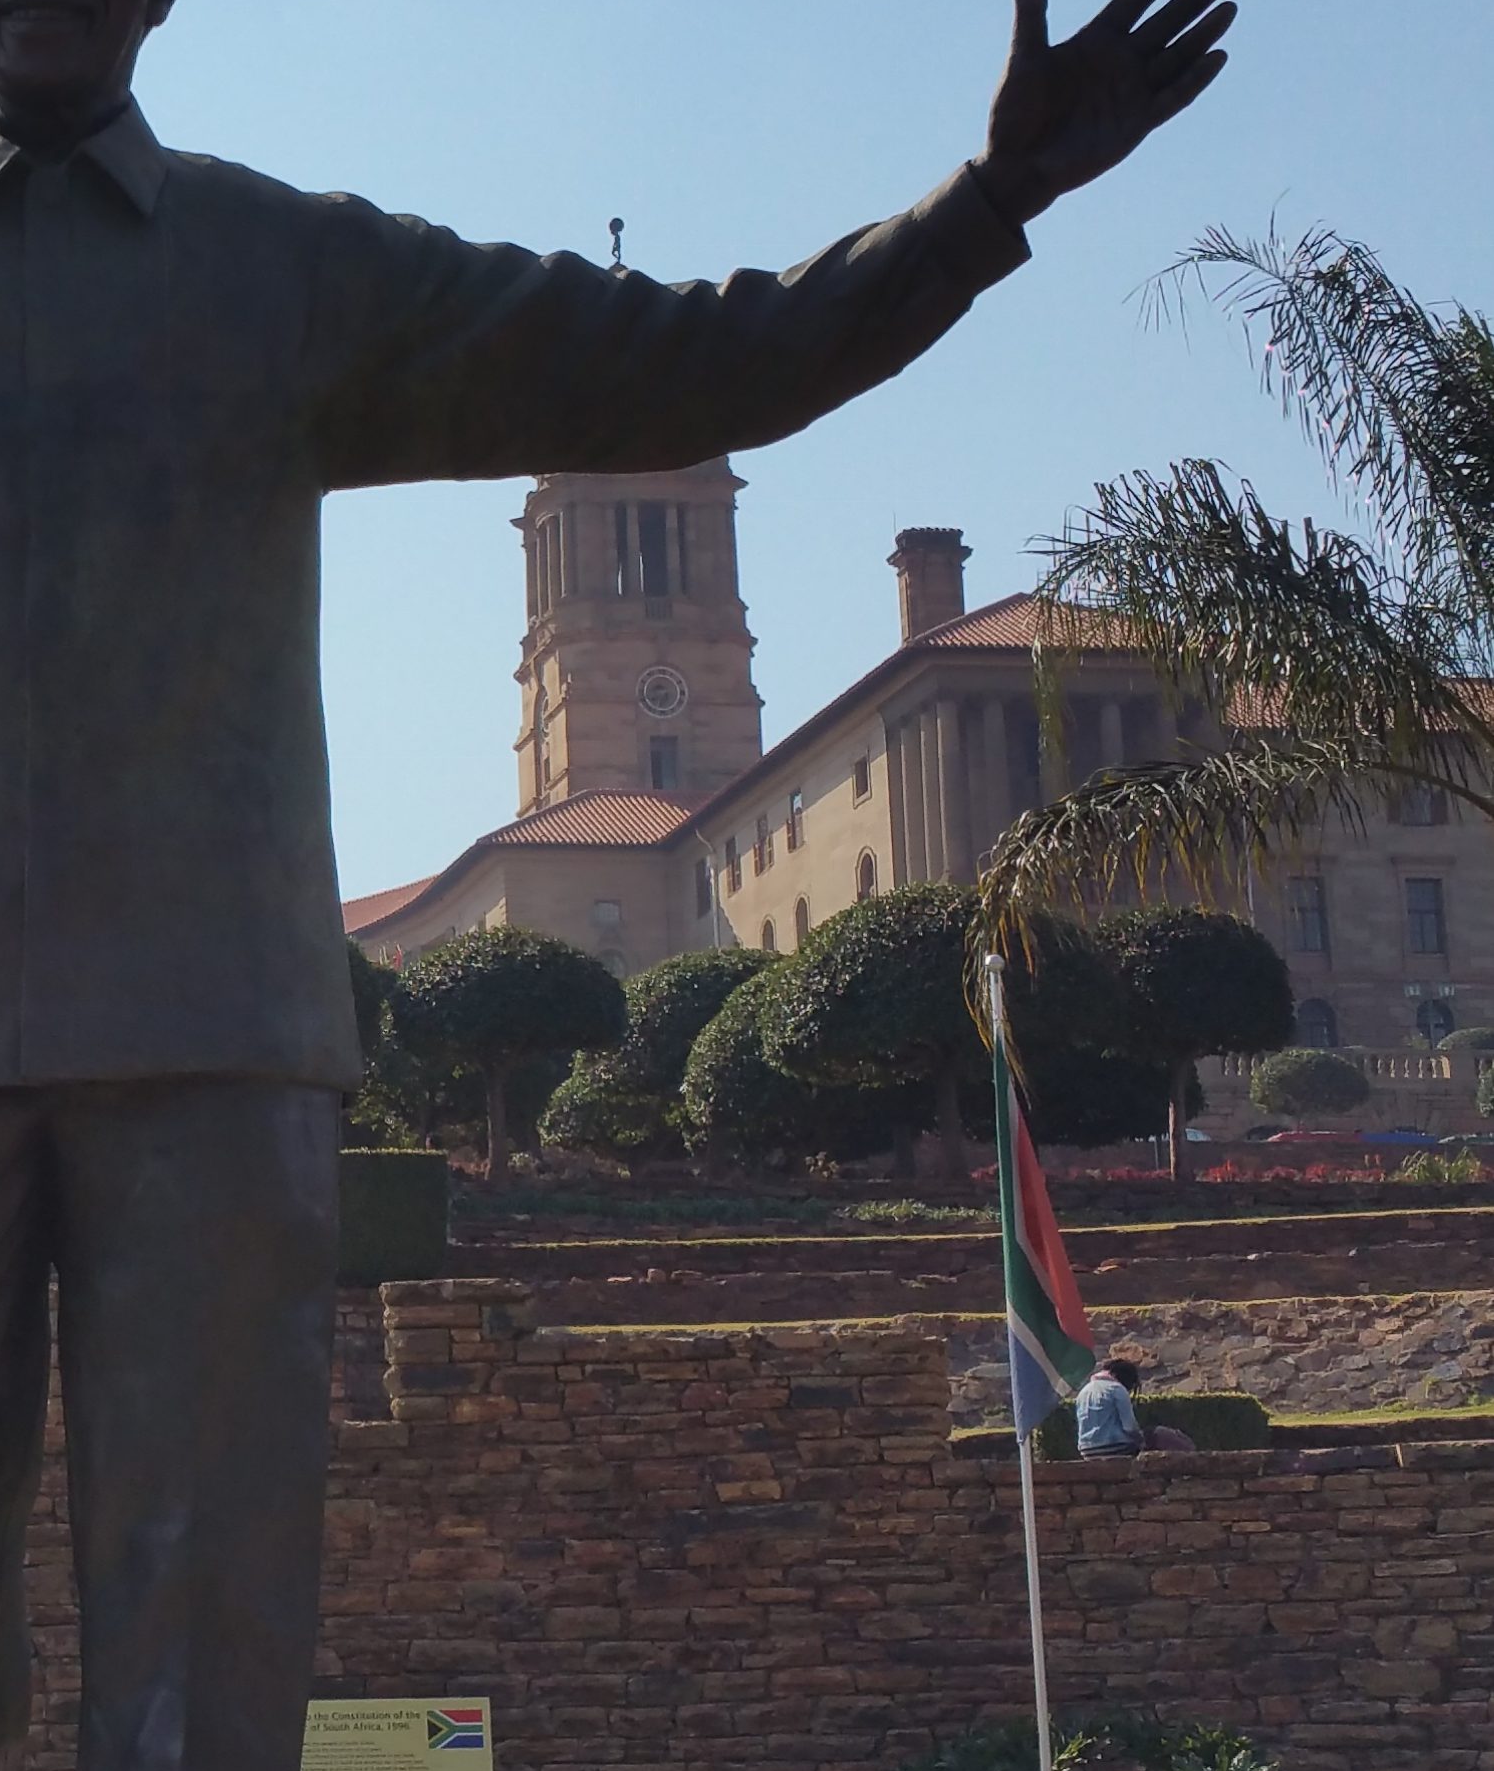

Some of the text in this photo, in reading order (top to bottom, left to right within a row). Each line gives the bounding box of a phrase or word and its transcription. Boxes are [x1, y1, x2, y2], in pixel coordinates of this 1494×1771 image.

[314, 1712, 329, 1720] the
[331, 1711, 391, 1721] Constitution
[393, 1710, 403, 1719] of
[405, 1711, 421, 1719] the
[310, 1723, 320, 1731] of
[323, 1723, 350, 1732] South
[353, 1722, 384, 1732] Africa,
